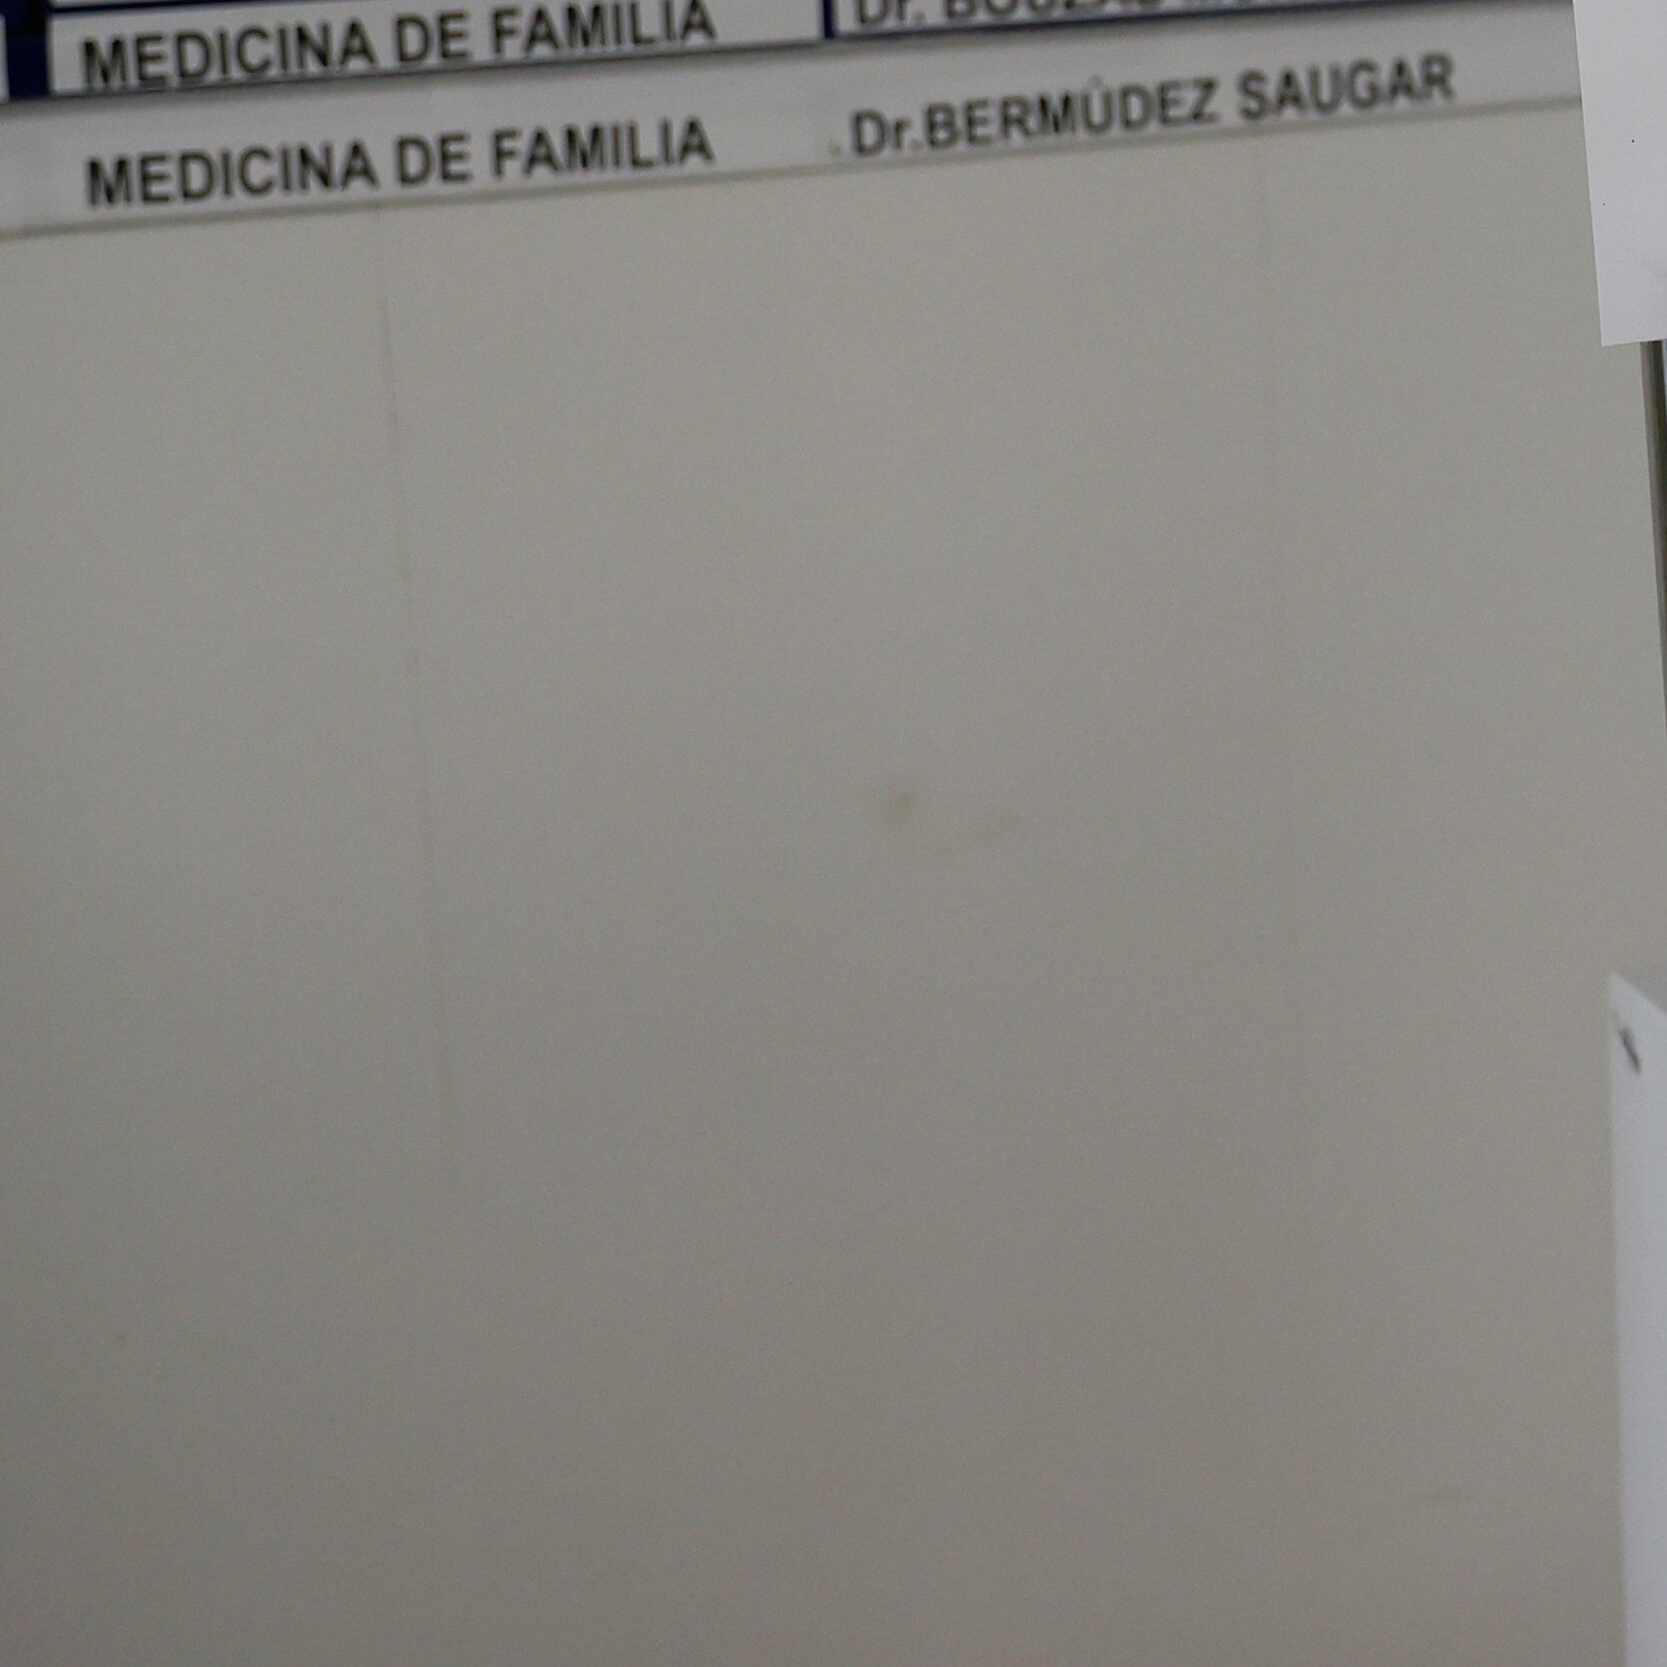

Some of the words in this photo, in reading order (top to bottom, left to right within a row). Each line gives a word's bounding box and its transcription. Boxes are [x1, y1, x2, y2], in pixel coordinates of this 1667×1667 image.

[1236, 52, 1456, 121] SAUGAR
[88, 139, 379, 208] MEDICINA
[399, 130, 471, 186] DE
[492, 118, 715, 176] FAMILIA
